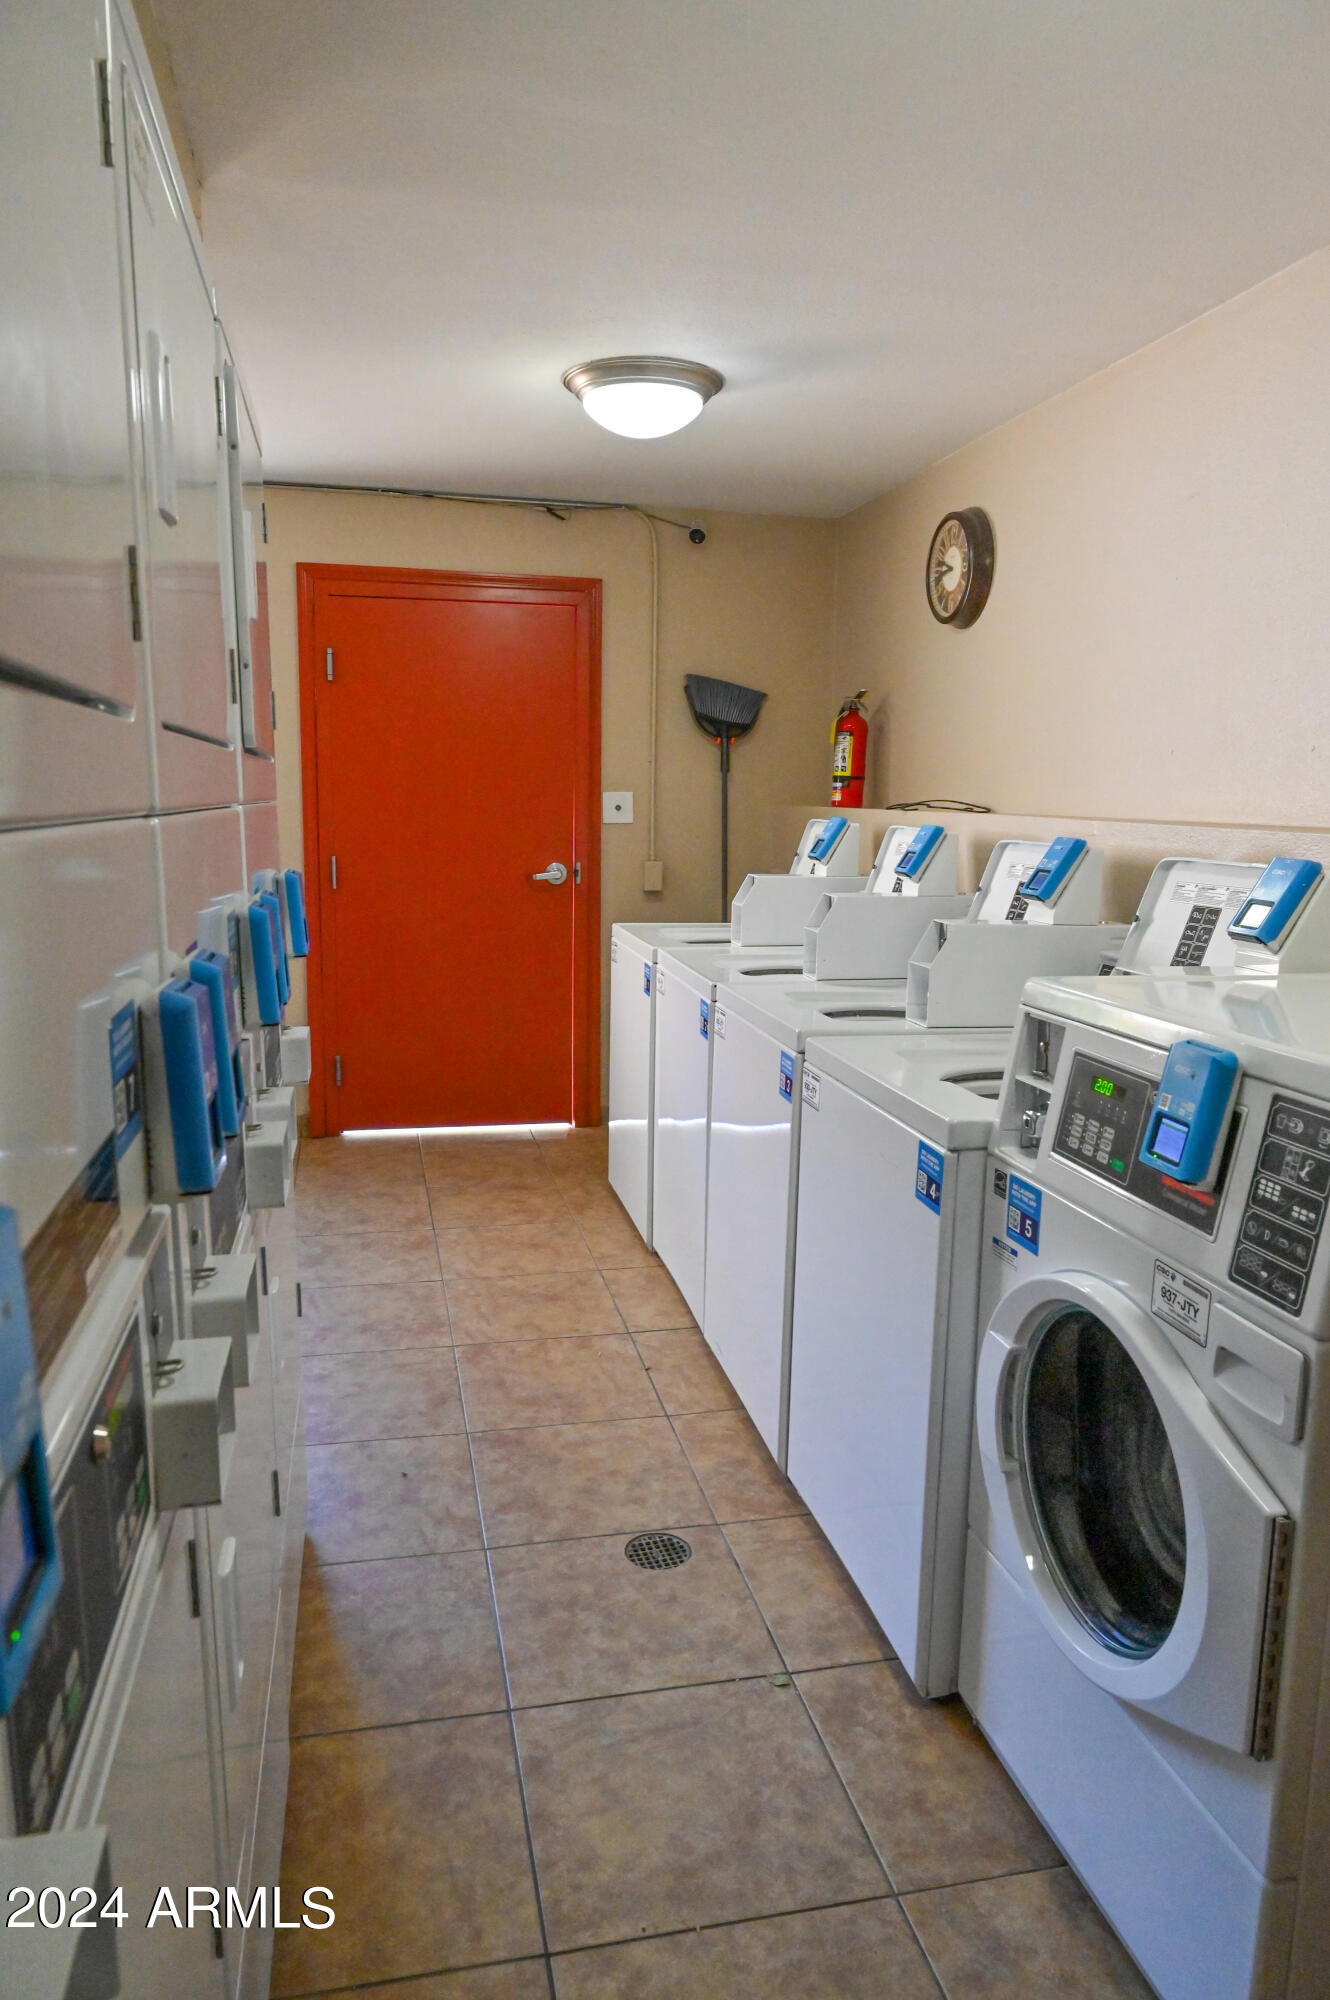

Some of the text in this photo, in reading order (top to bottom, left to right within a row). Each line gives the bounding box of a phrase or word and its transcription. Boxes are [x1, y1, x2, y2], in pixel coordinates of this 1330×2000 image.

[929, 1183, 936, 1200] 4
[1024, 1219, 1032, 1238] 5
[1160, 1286, 1200, 1318] 937-JTY
